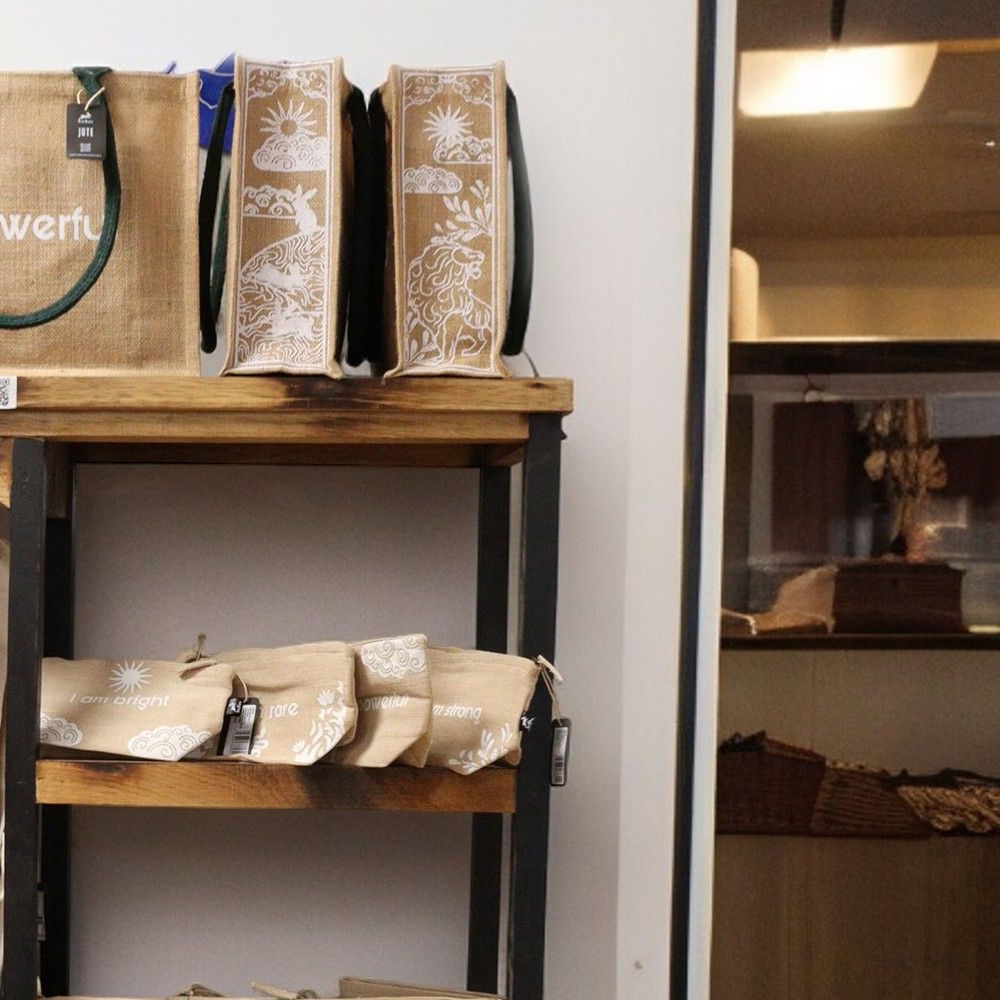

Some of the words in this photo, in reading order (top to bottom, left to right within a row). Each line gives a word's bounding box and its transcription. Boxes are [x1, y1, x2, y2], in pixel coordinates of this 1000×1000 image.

[77, 127, 94, 139] JUTE
[80, 696, 109, 704] am
[112, 694, 171, 711] bright
[268, 702, 299, 719] rare
[444, 703, 482, 725] strong
